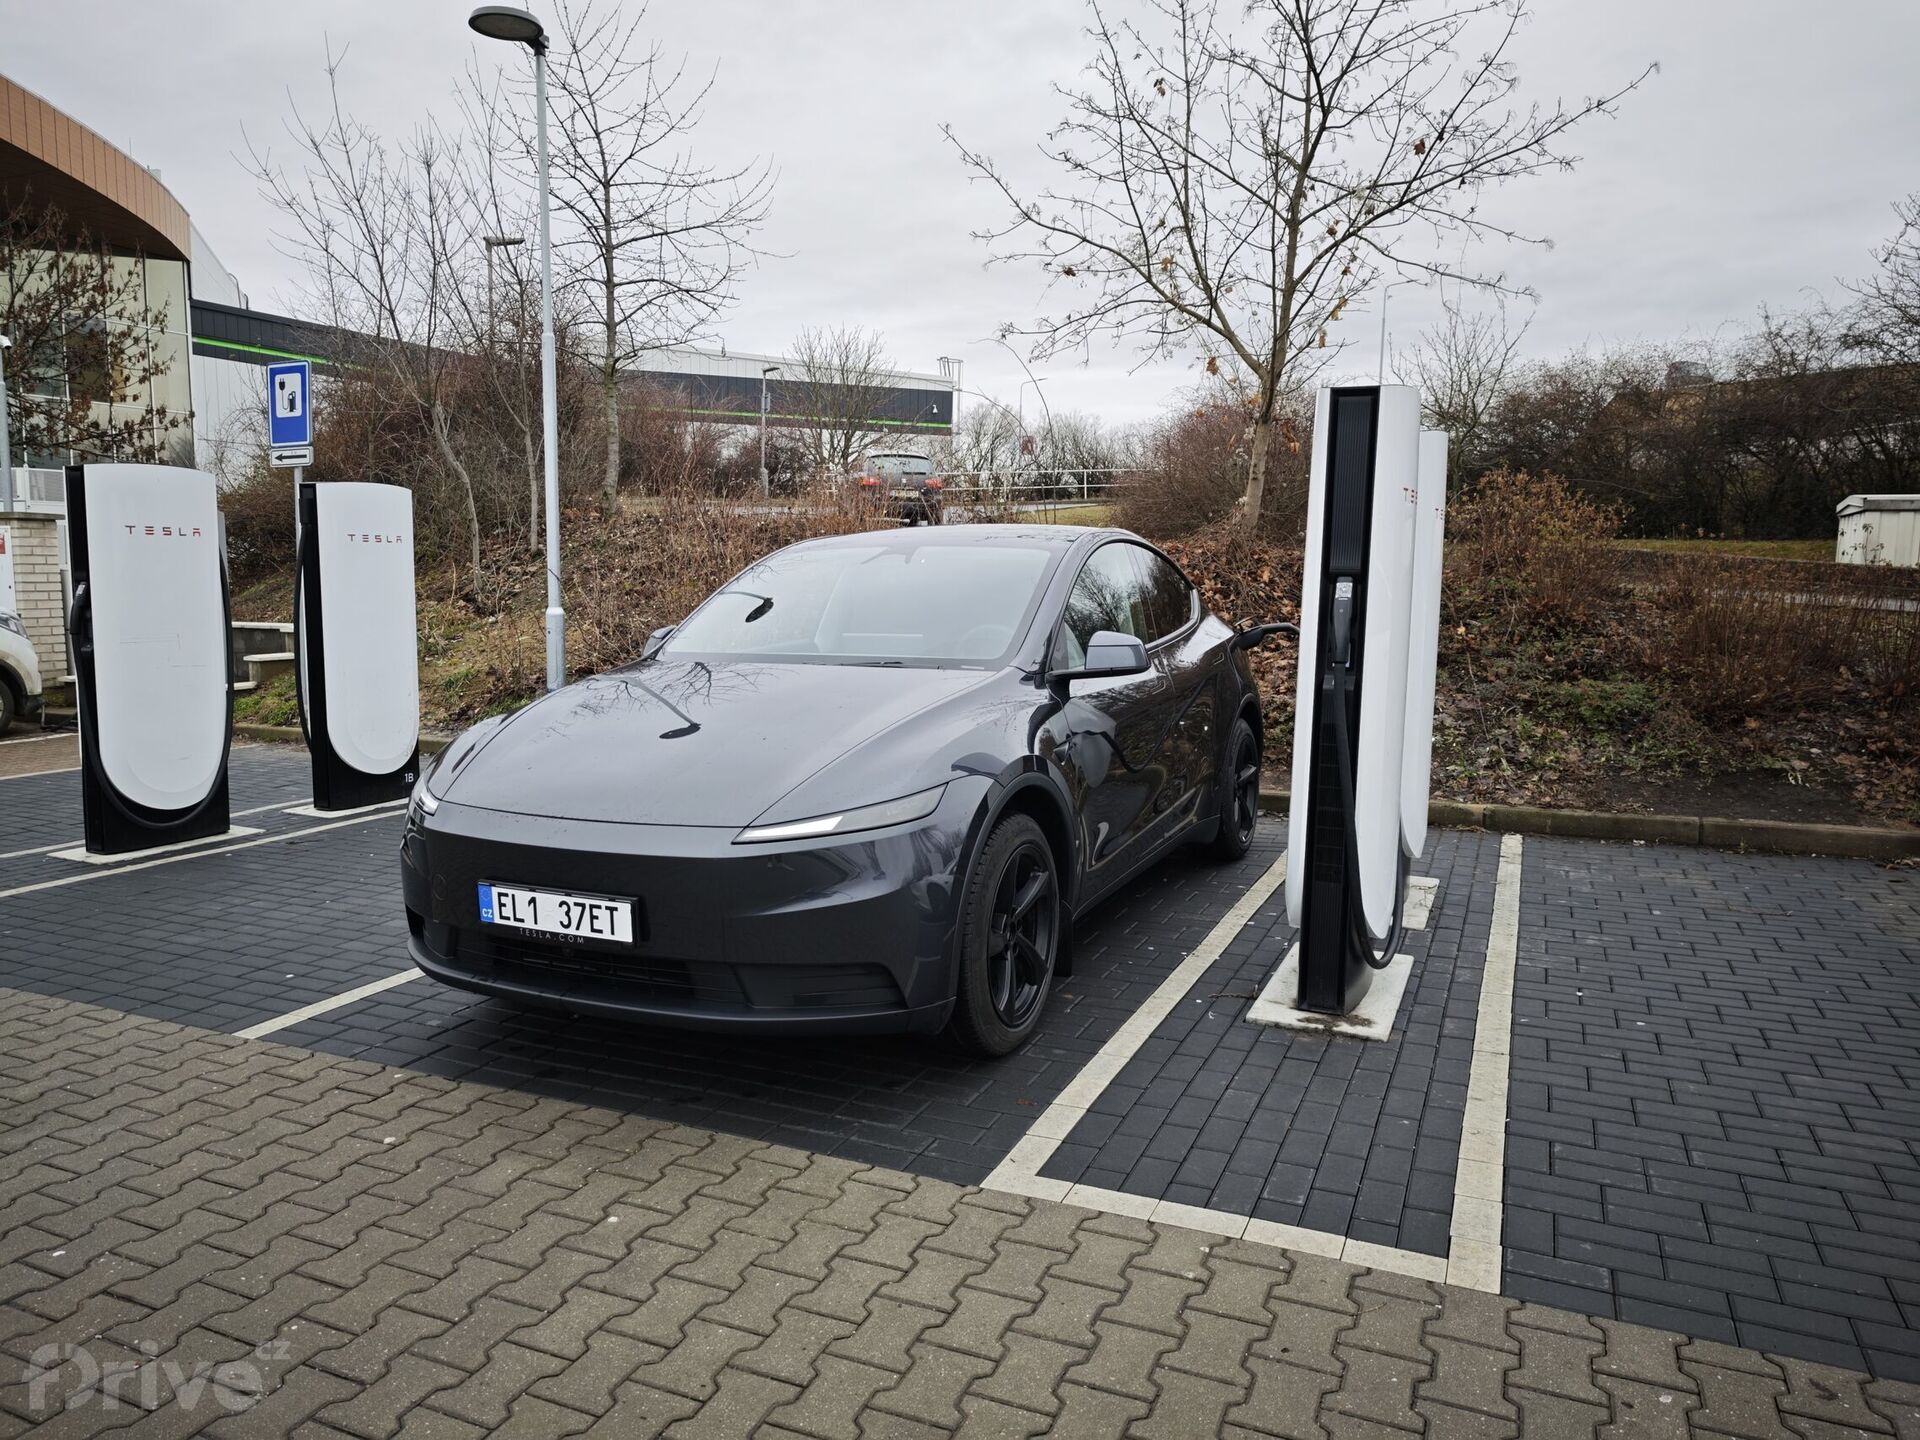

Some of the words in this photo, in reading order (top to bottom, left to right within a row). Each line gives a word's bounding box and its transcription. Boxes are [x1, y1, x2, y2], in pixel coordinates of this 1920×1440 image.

[124, 525, 201, 537] TESLA
[347, 533, 403, 544] TESLA
[404, 772, 414, 783] 1B
[482, 908, 493, 918] CZ
[497, 891, 538, 925] EL1
[558, 900, 619, 936] 37ET
[519, 928, 585, 944] TESLA.COM
